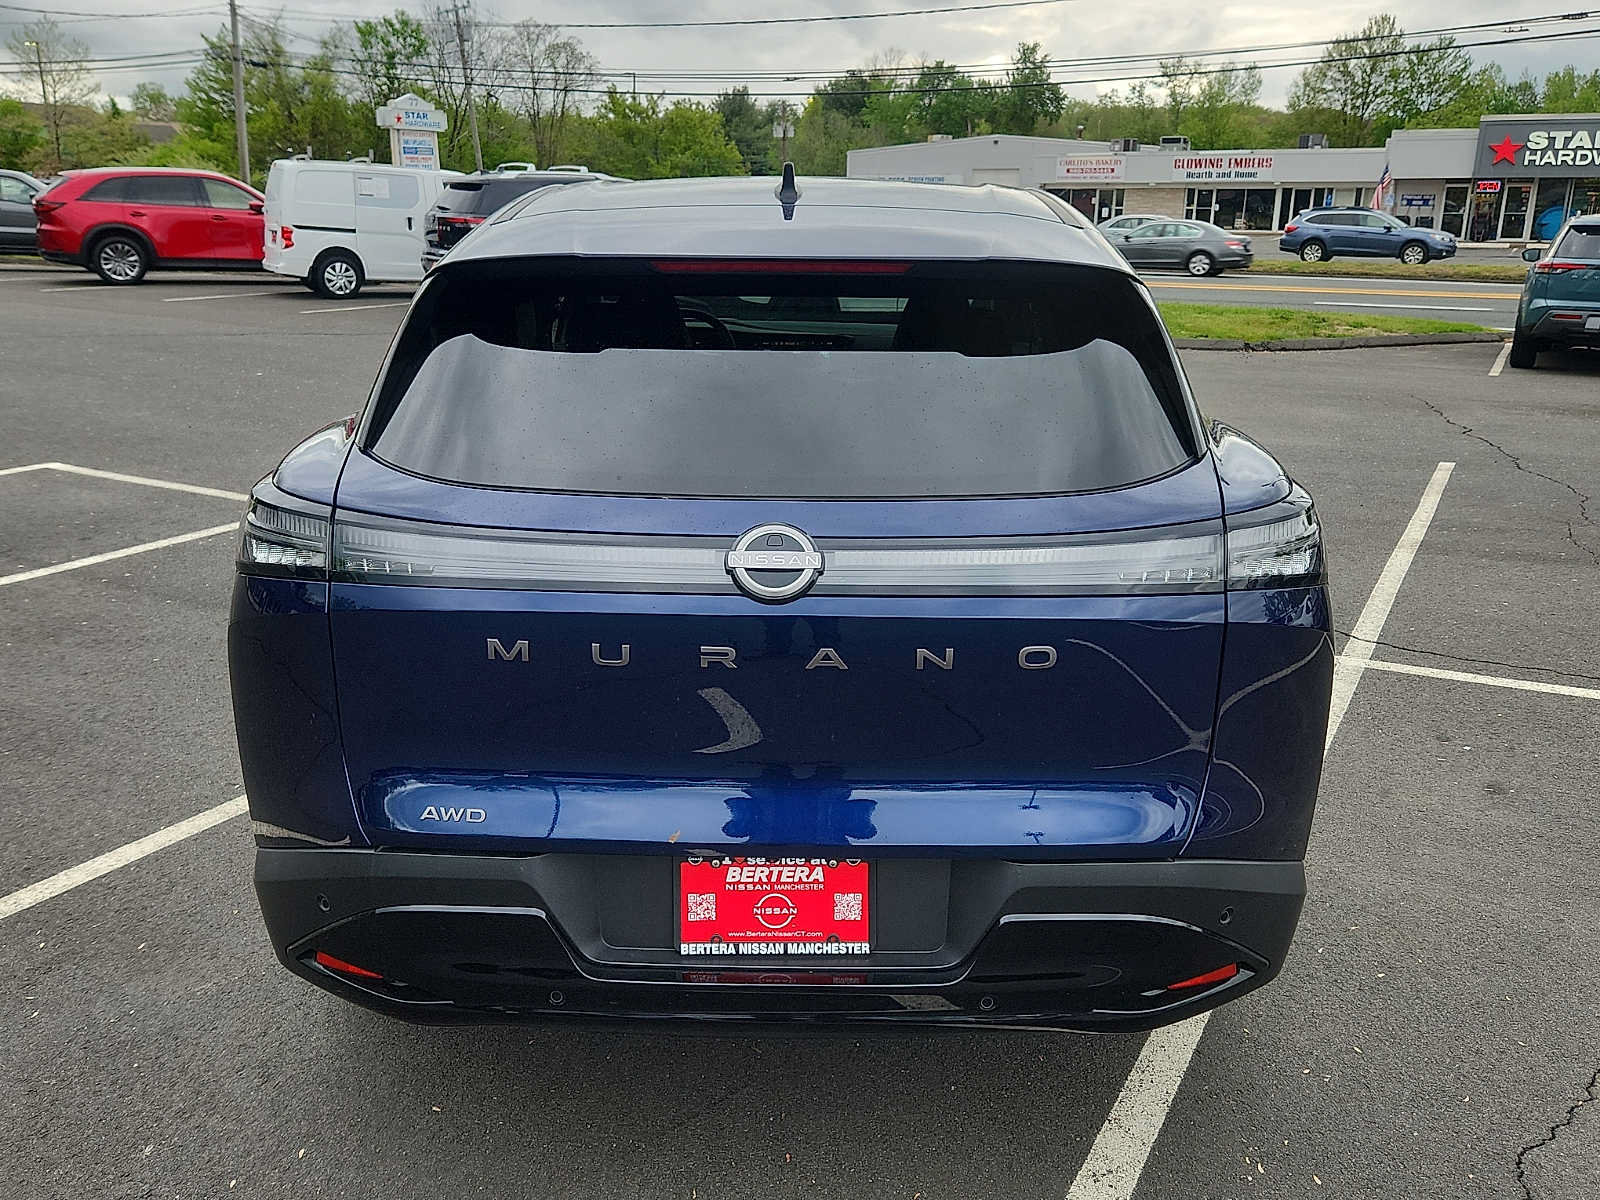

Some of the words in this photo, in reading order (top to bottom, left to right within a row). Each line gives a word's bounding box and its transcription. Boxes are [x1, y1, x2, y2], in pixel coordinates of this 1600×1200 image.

[404, 111, 428, 120] STAR
[1527, 131, 1600, 149] STA
[1174, 157, 1223, 169] GLOWING
[1228, 157, 1273, 168] EMBERS
[1186, 170, 1213, 179] Hearth
[1215, 170, 1231, 178] and
[1234, 170, 1258, 178] Home
[731, 554, 819, 566] NISSAN
[486, 637, 1058, 671] MURANO
[419, 806, 487, 823] AWD
[725, 866, 825, 883] BERTERA
[725, 883, 771, 891] NISSAN
[774, 883, 825, 891] MANCHESTER
[753, 907, 798, 915] NISSAN
[728, 930, 823, 938] www.BerteraNissanCT.com
[680, 942, 736, 955] BERTERA
[738, 943, 784, 955] NISSAN
[787, 943, 871, 955] MANCHESTER
